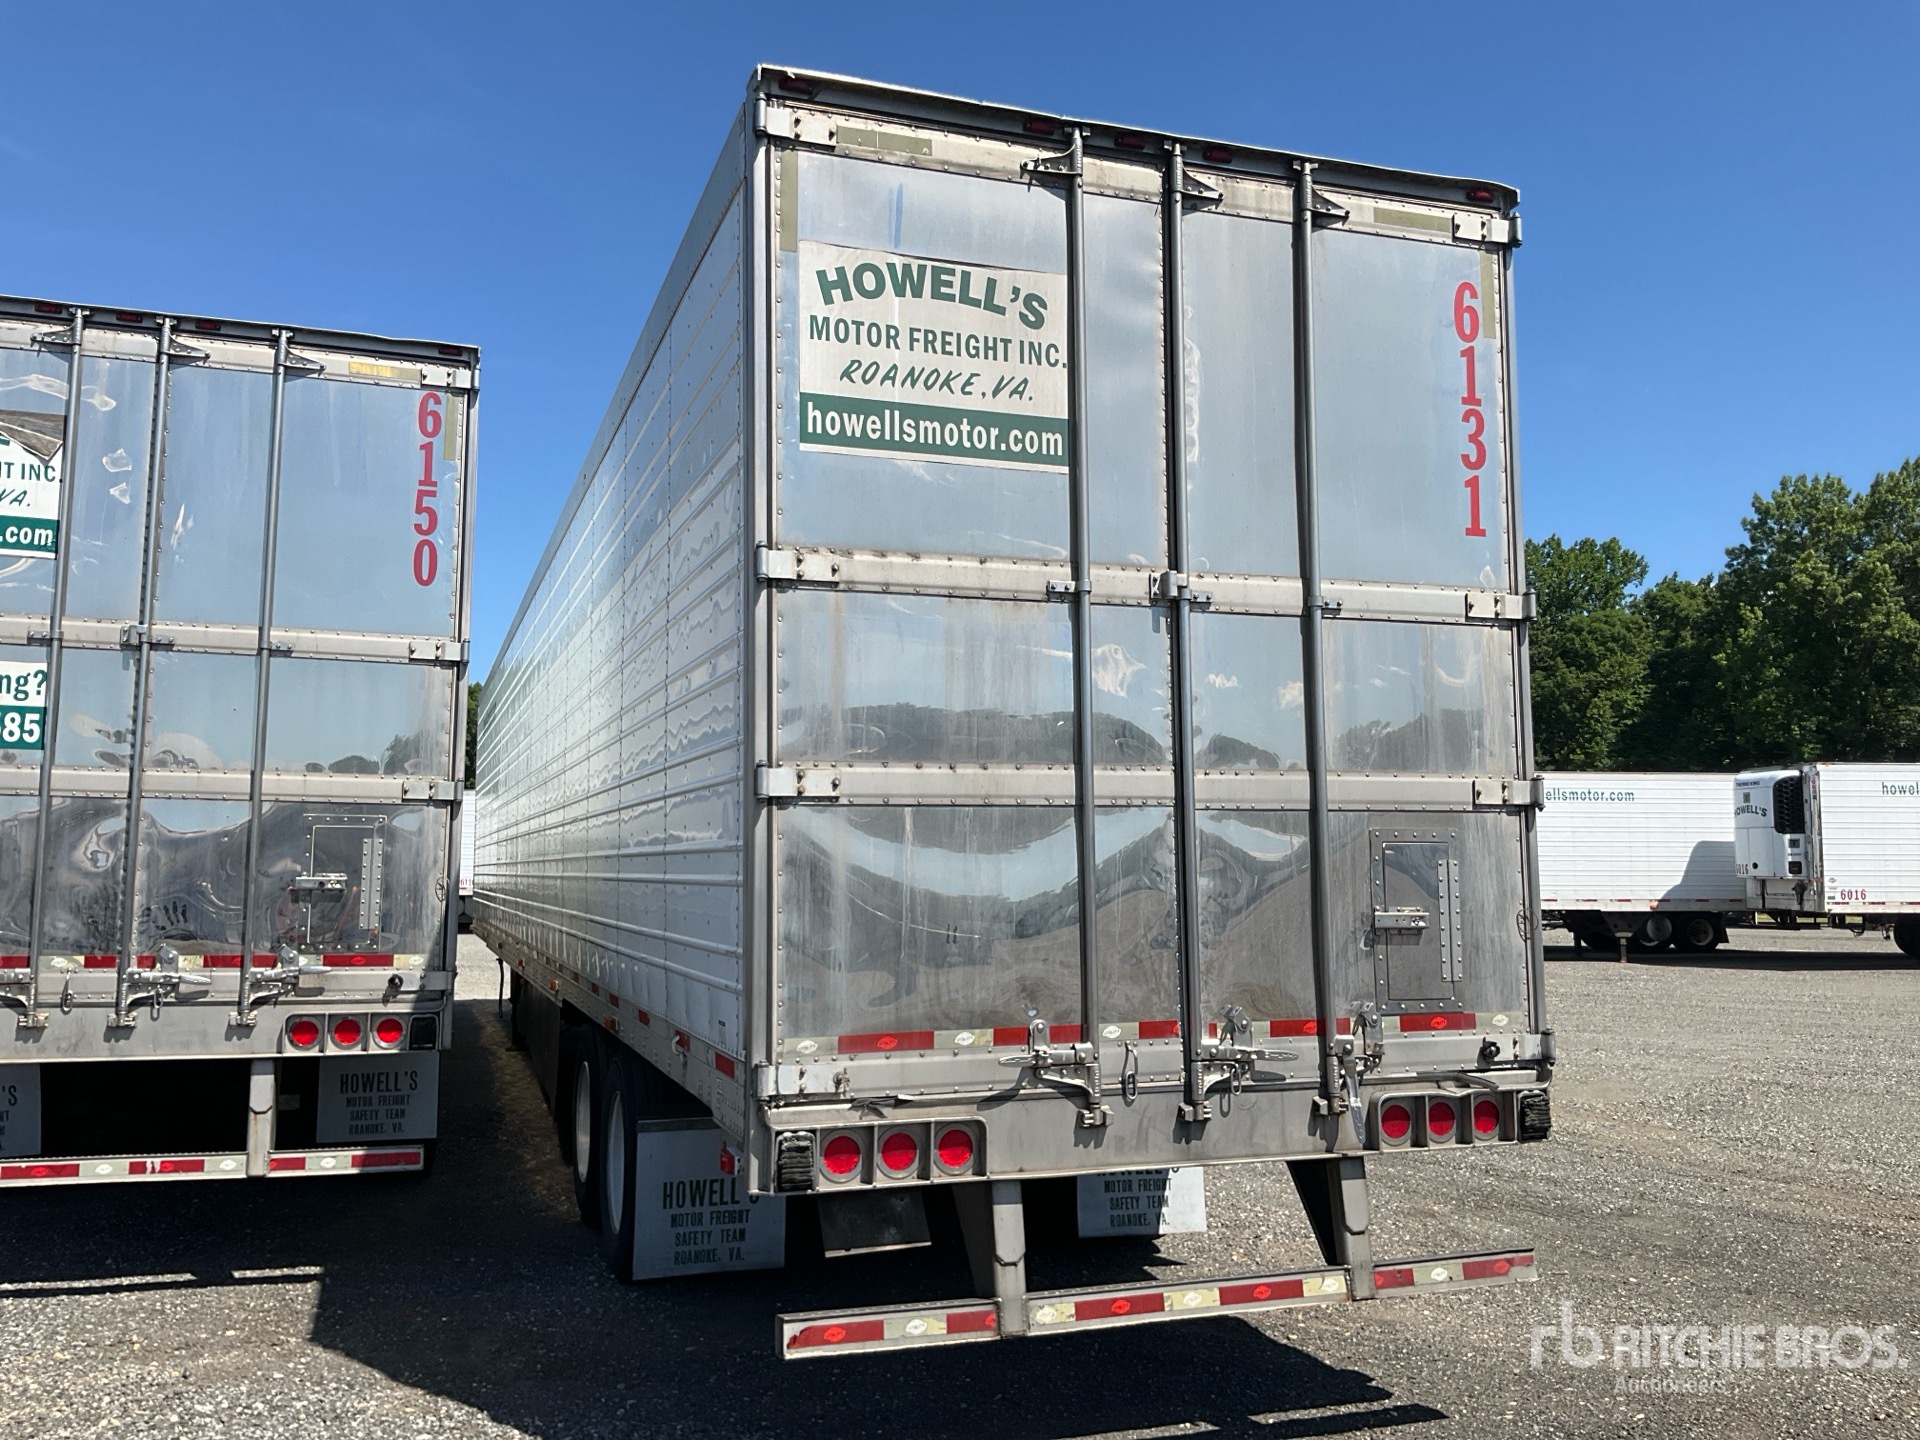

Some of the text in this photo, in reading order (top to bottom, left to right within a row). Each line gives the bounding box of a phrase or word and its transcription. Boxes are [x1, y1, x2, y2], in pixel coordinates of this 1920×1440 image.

[814, 262, 1048, 330] HOWELL'S
[809, 314, 1068, 369] MOTOR FREIGHT INC.
[1453, 281, 1487, 538] 6131
[806, 401, 1064, 456] howellsmotor.com
[413, 391, 443, 587] 6150
[0, 711, 41, 743] 85
[1840, 889, 1867, 901] 6016
[340, 1070, 418, 1094] HOWELL'S
[346, 1094, 411, 1108] MOTOR FREIGHT
[350, 1108, 406, 1121] SAFETY TEAM
[662, 1177, 760, 1209] HOWELL
[1104, 1178, 1172, 1193] MOTOR FREIGHT
[1109, 1195, 1169, 1211] SAFETY TEAM
[670, 1209, 751, 1228] MOTOR FREIGHT
[674, 1228, 746, 1247] SAFETY TEAM
